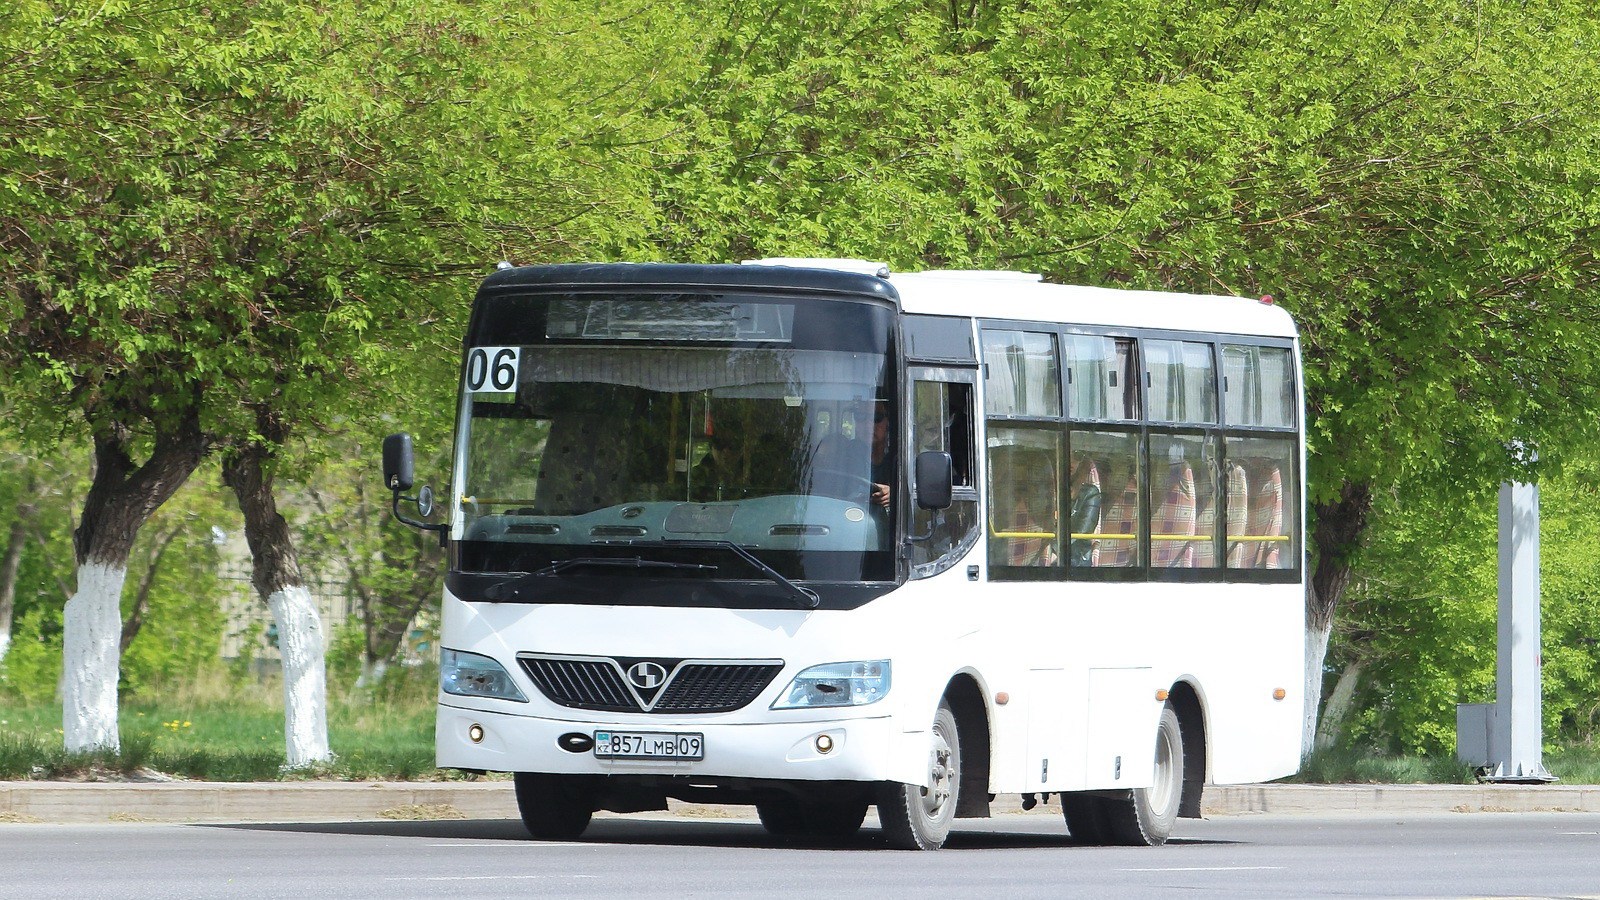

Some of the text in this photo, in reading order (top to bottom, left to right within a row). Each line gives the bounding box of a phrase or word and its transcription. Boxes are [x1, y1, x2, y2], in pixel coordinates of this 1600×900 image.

[467, 348, 516, 391] 06
[597, 744, 609, 753] KZ
[679, 737, 700, 756] 09
